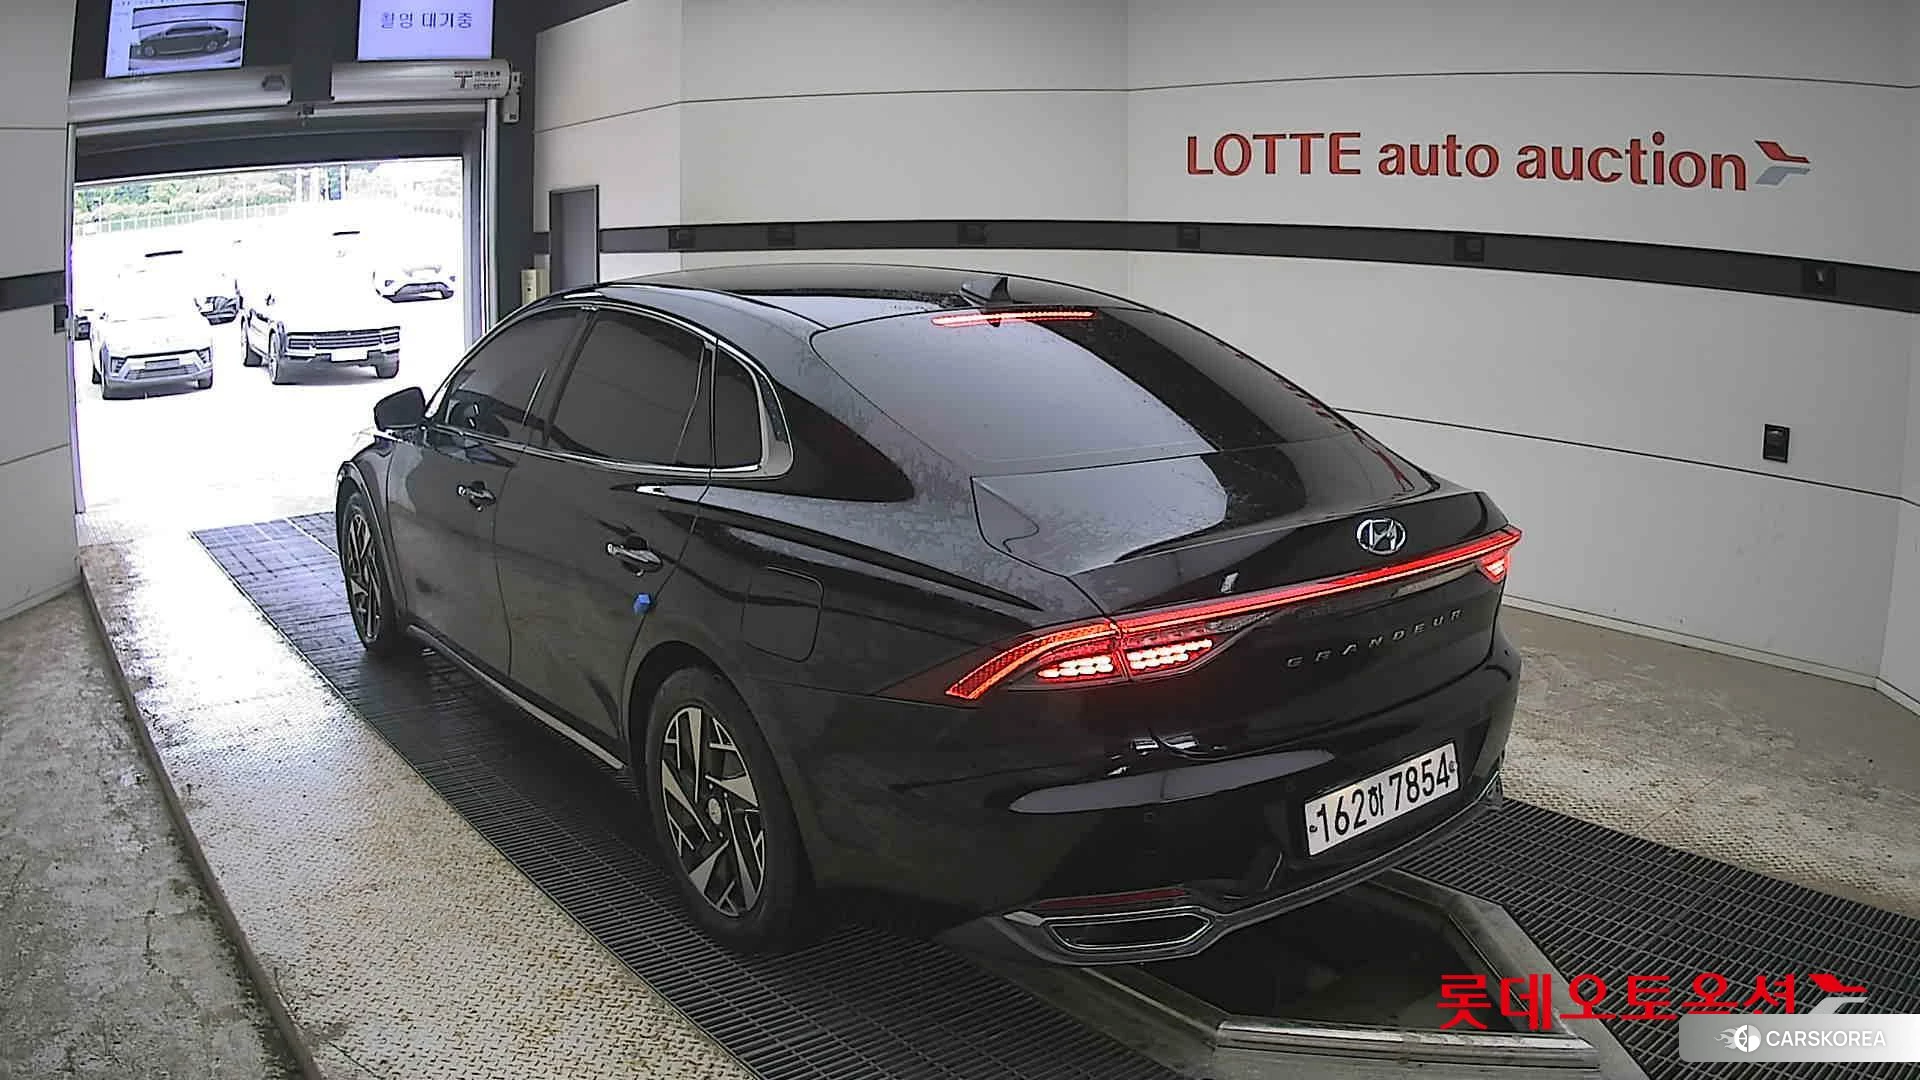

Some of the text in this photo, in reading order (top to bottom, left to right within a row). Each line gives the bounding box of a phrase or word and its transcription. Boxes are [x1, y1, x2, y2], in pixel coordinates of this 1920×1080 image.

[421, 11, 472, 29] 대기중
[1187, 131, 1748, 191] LOTTE auto auction
[1287, 608, 1463, 668] GRANDEUR
[1388, 751, 1450, 812] 7854
